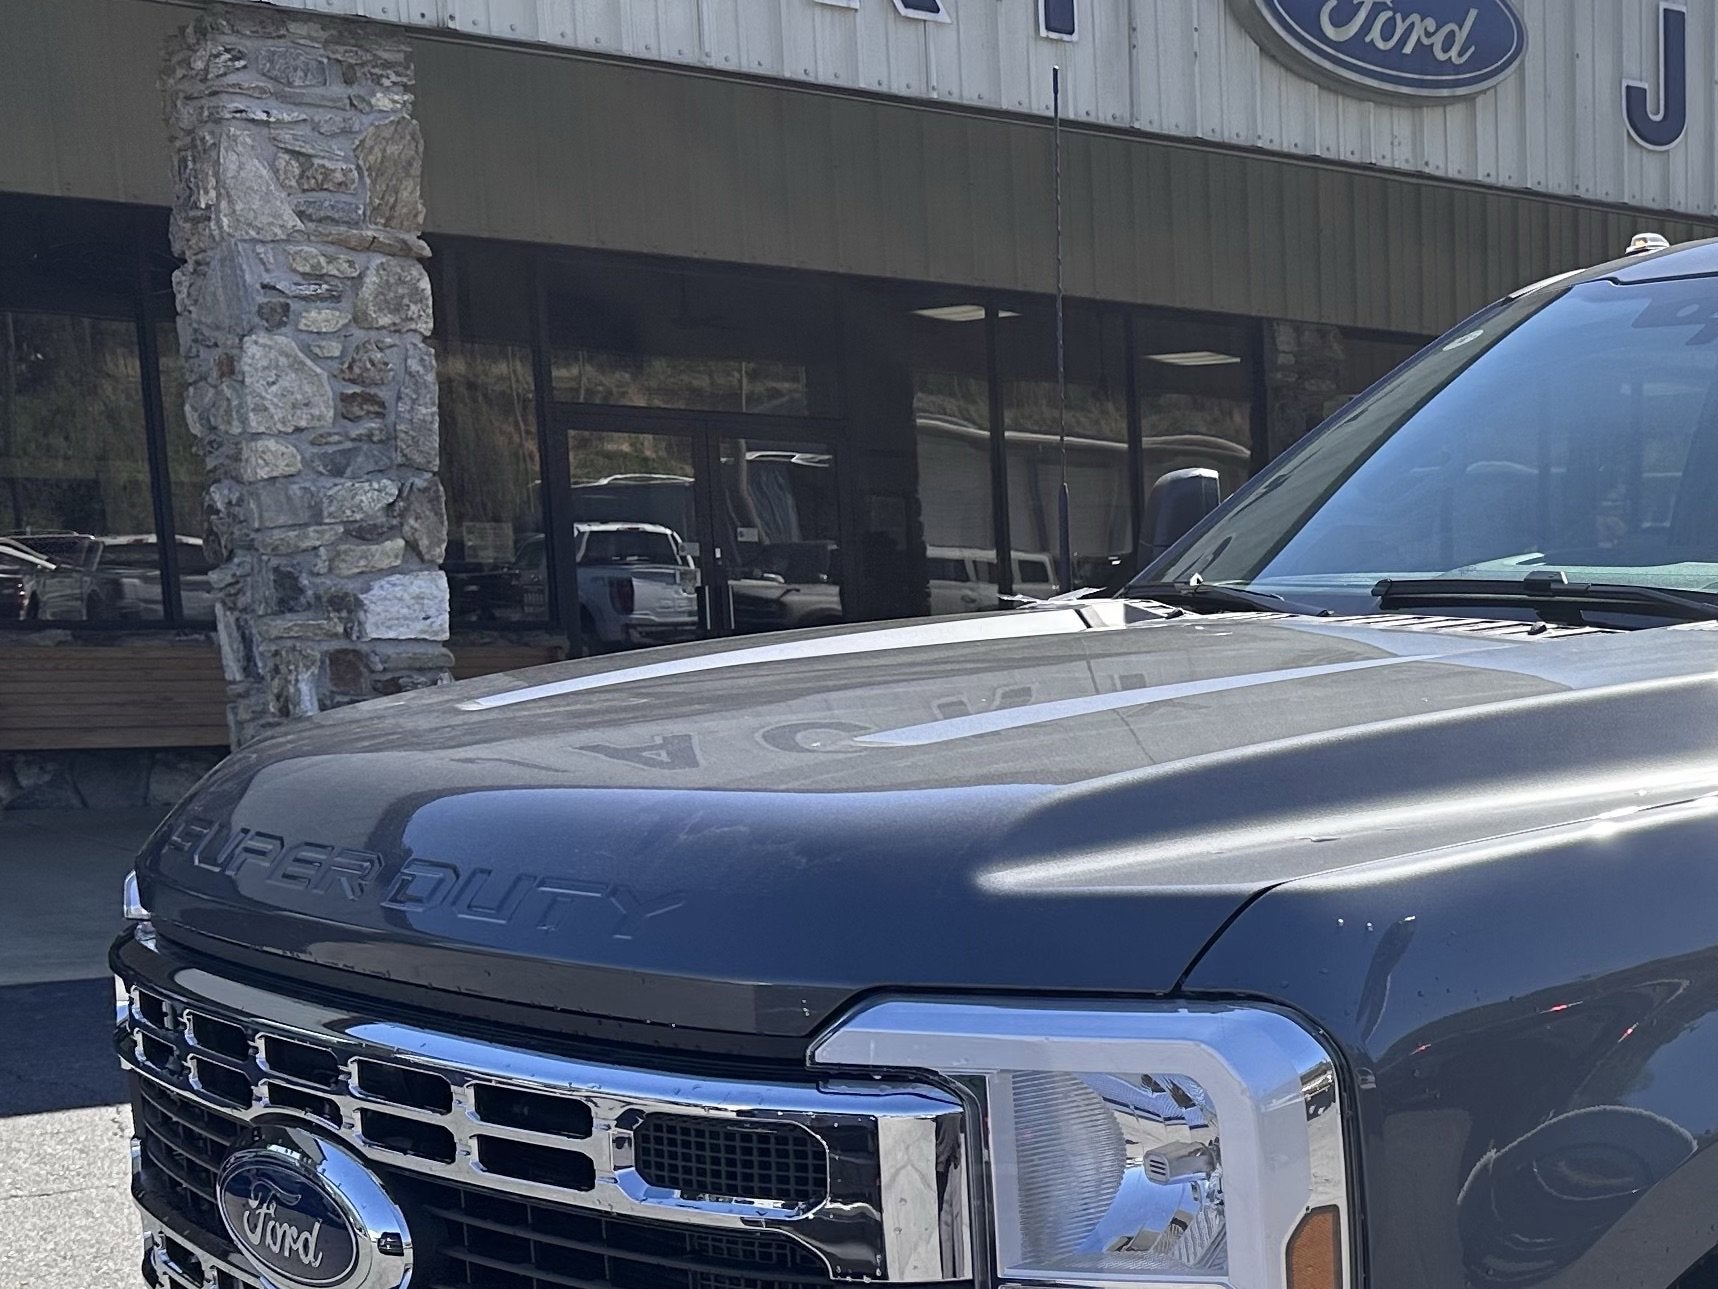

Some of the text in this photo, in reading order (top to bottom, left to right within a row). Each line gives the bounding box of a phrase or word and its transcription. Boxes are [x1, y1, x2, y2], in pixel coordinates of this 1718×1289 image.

[161, 817, 687, 941] SUPER DUTY
[243, 1176, 323, 1268] Ford
